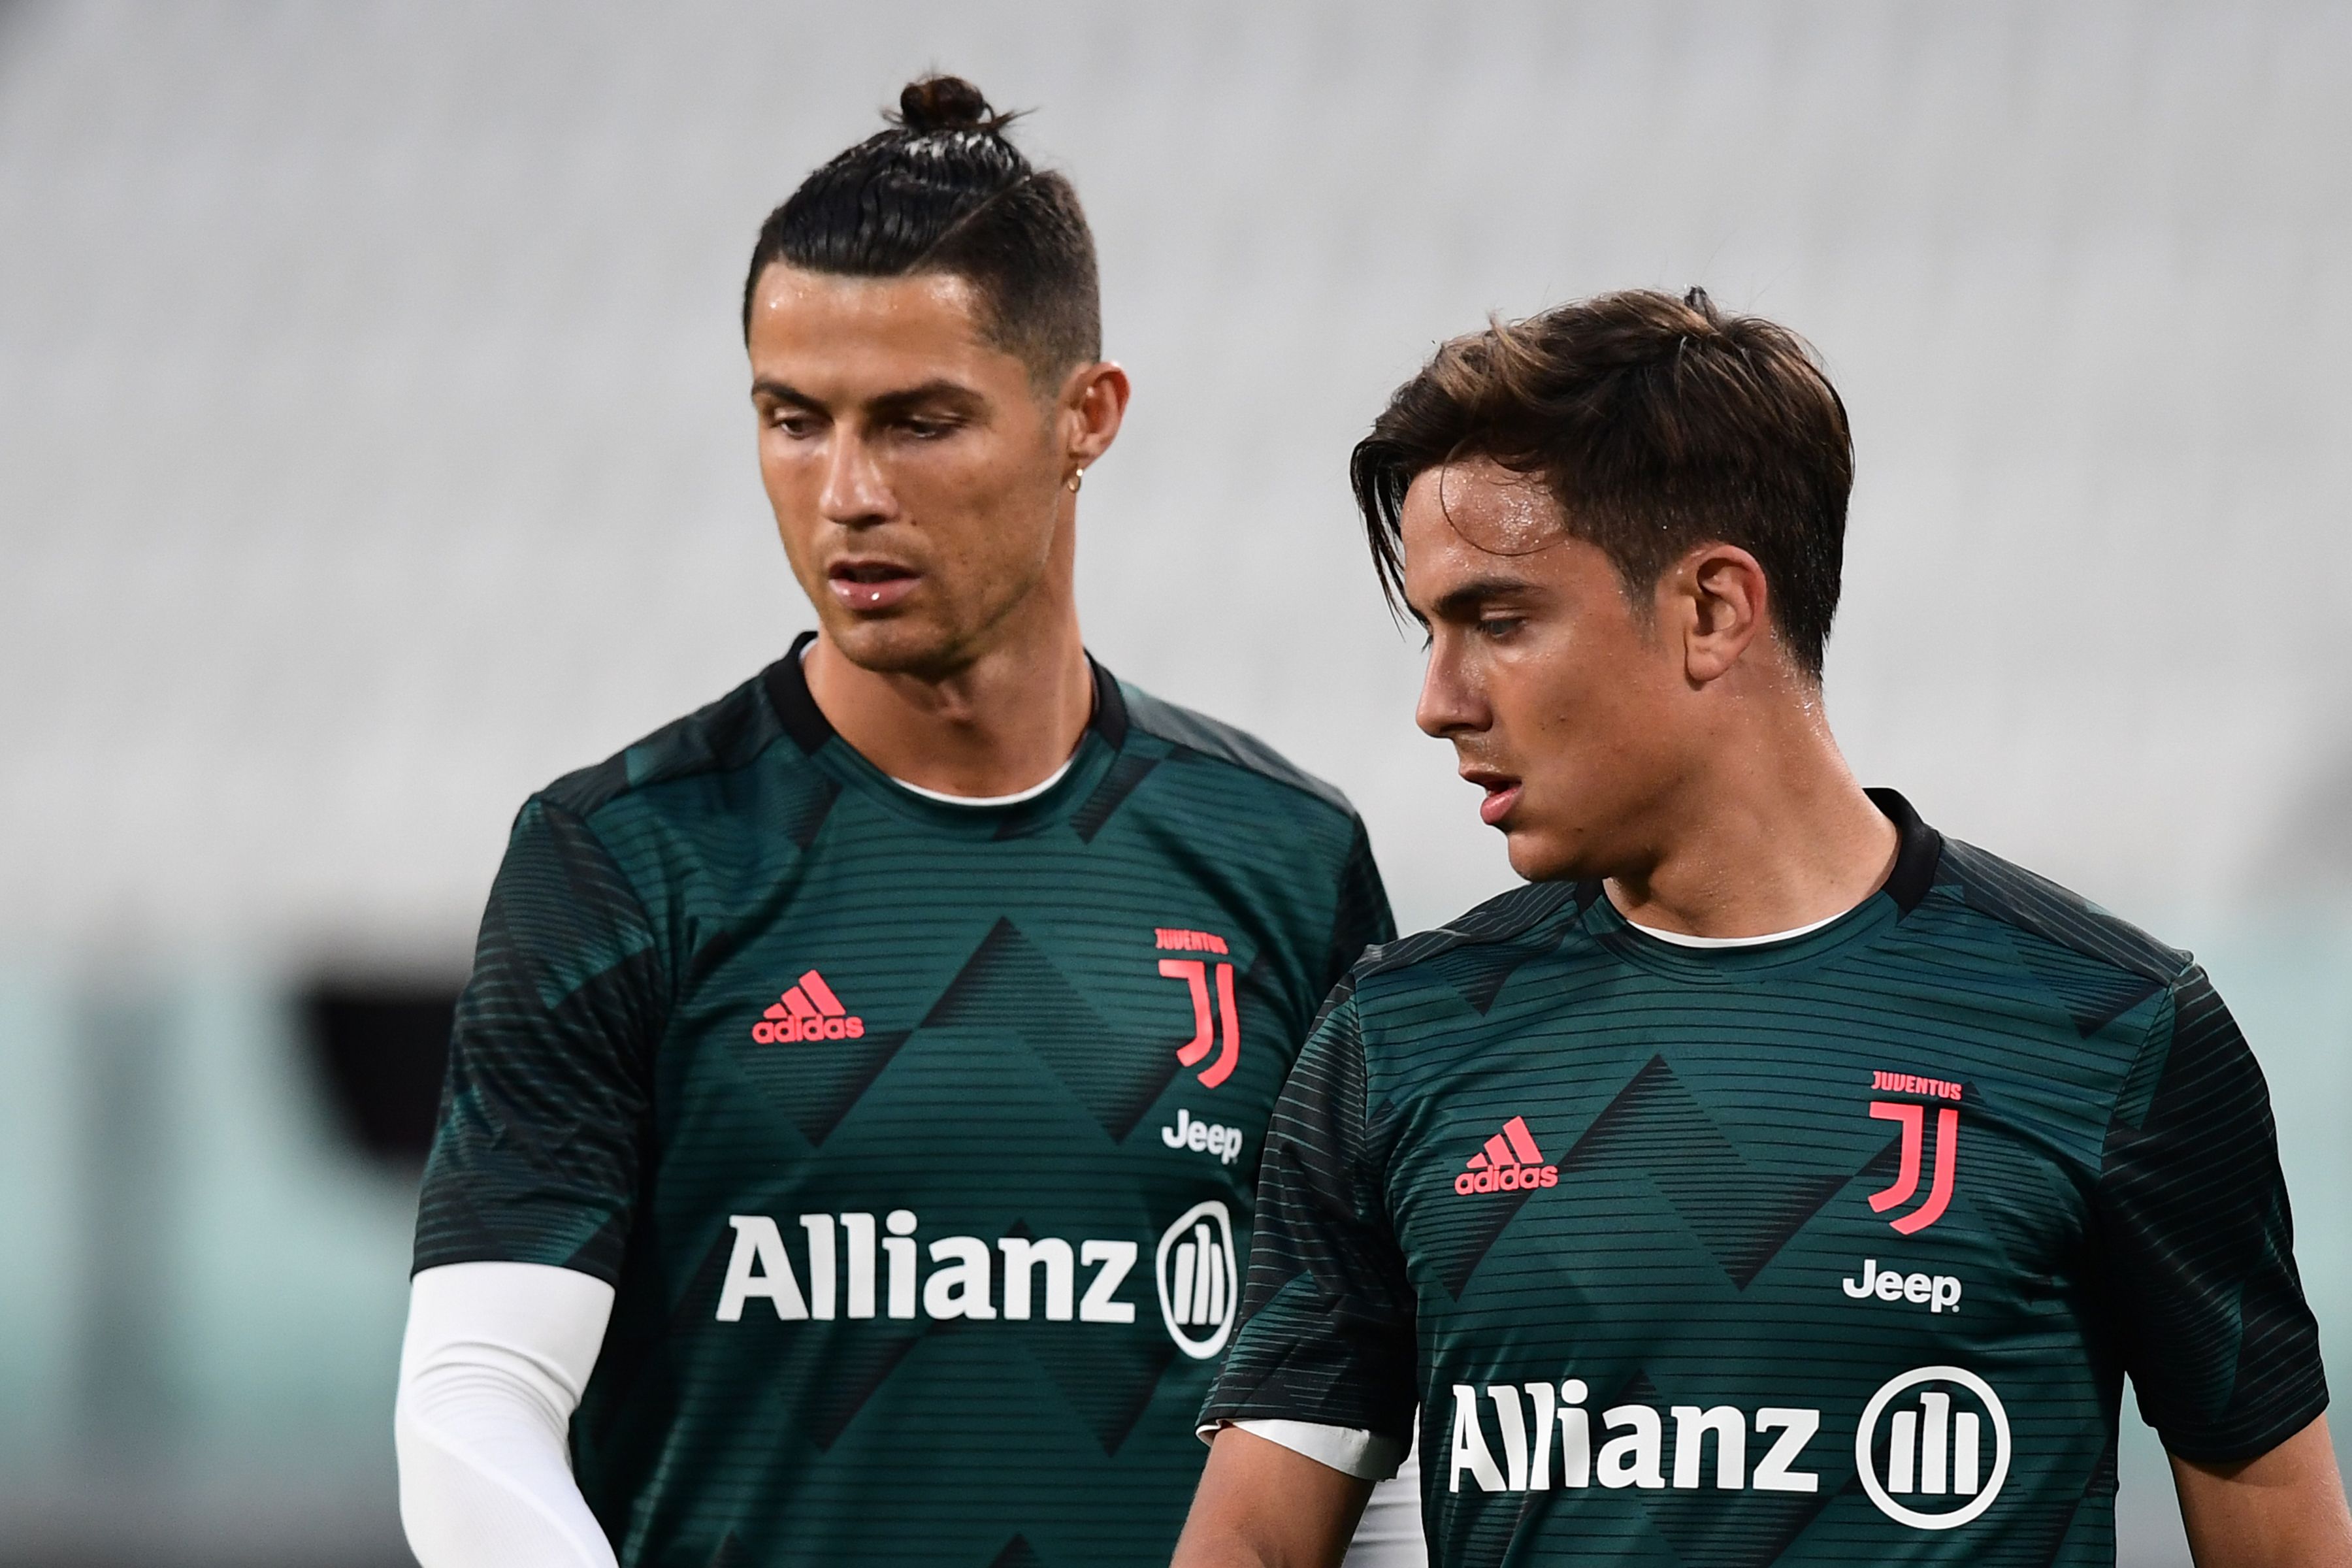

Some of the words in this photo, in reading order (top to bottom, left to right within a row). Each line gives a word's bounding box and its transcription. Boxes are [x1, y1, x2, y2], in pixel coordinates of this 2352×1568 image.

[1154, 928, 1229, 955] JUVENT
[752, 1014, 864, 1044] adidas
[1871, 1070, 1962, 1101] JUVENTUS
[1162, 1109, 1242, 1164] Jeep
[1454, 1162, 1558, 1196] adidas
[716, 1209, 1137, 1323] Allianz
[1842, 1259, 1961, 1313] Jeep
[1449, 1379, 1820, 1494] Allianz
